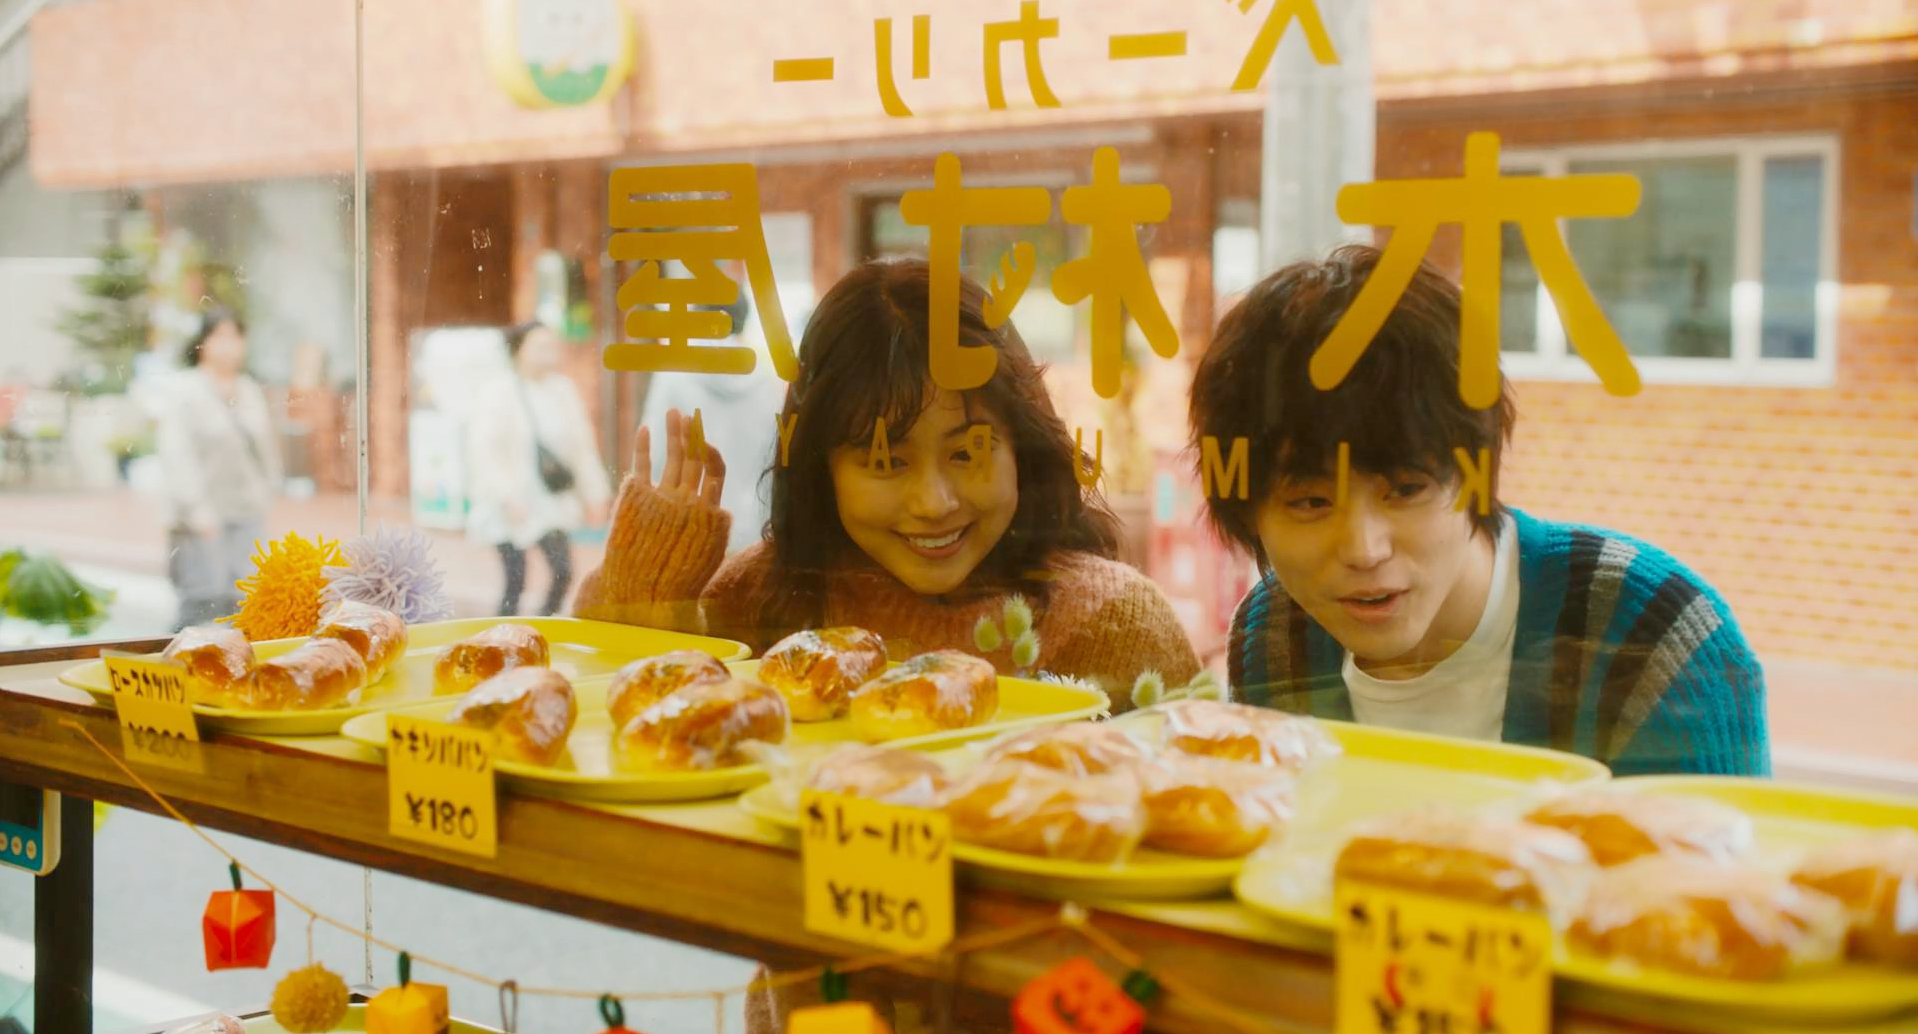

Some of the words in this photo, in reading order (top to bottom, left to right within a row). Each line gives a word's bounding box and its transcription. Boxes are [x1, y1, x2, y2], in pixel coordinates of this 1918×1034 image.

[127, 722, 190, 761] ¥200
[405, 792, 480, 840] ¥180
[807, 803, 945, 864] カレーパン
[827, 879, 928, 940] ¥150
